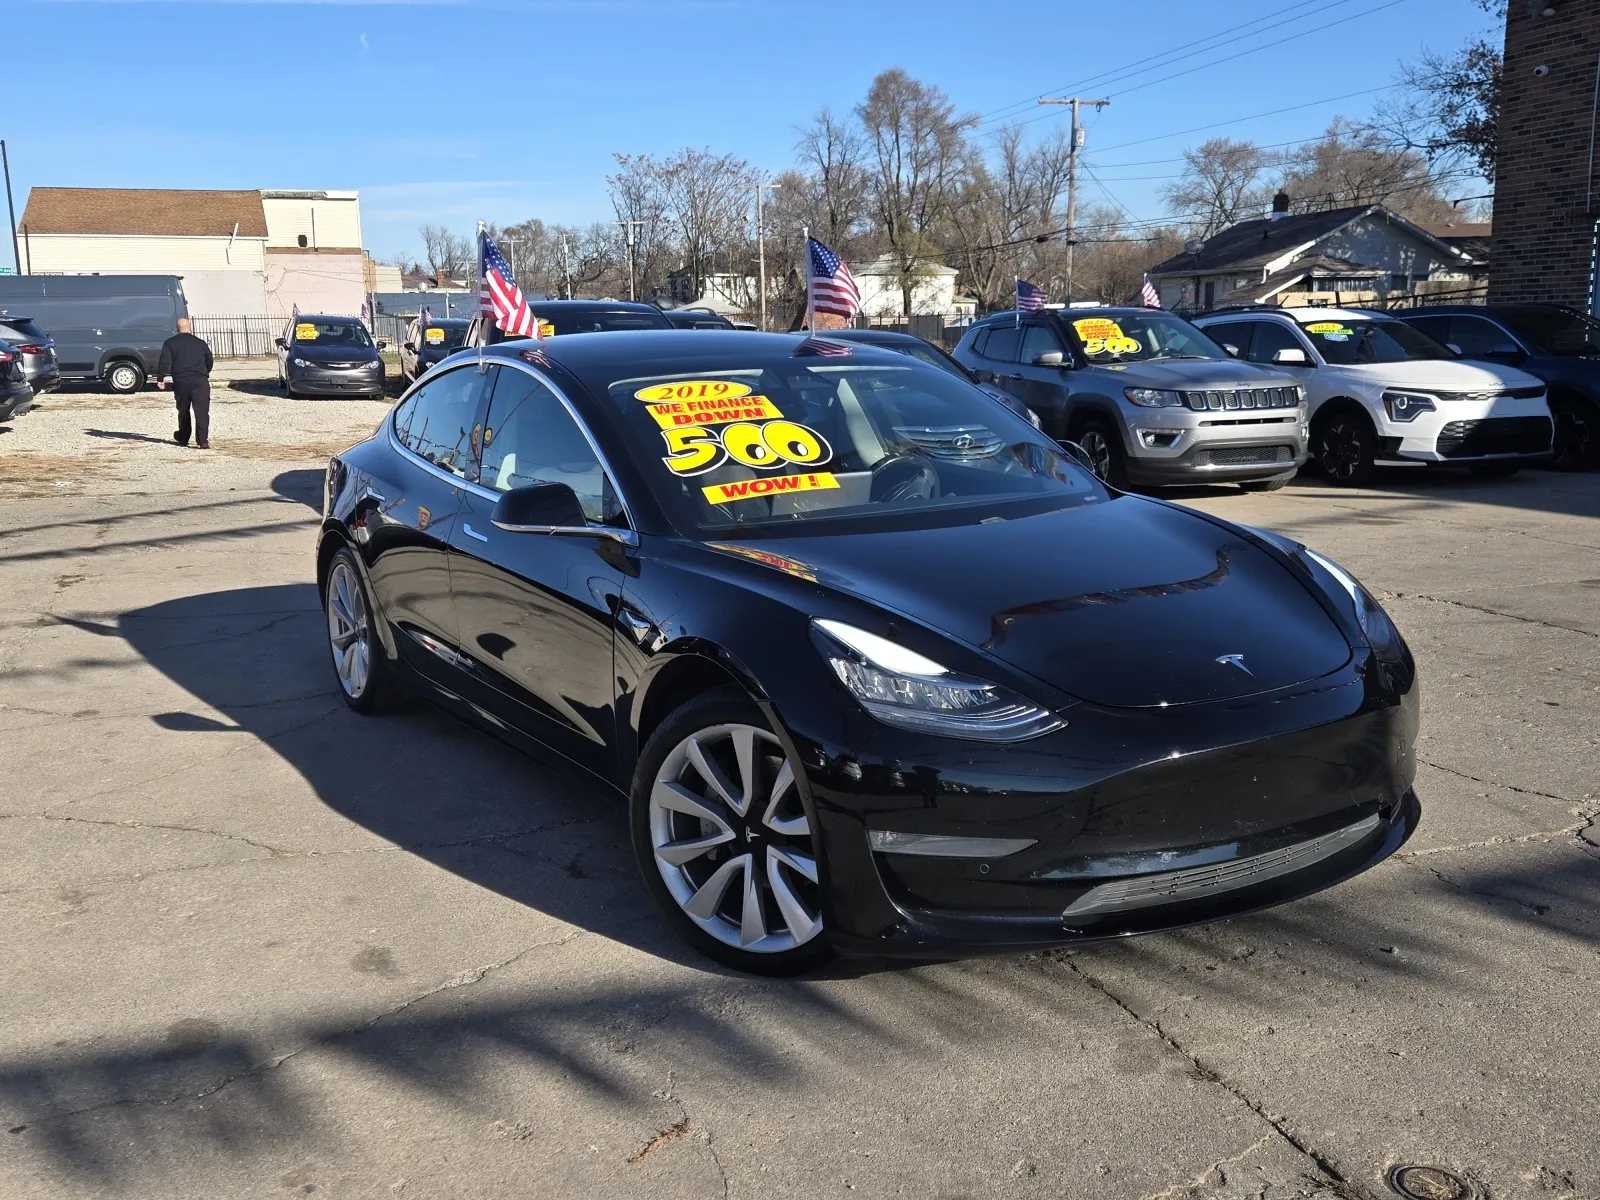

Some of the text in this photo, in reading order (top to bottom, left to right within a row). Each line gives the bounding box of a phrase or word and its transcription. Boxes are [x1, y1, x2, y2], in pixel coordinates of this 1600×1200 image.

[1084, 337, 1142, 355] 500
[658, 383, 730, 400] 2019
[653, 397, 765, 416] WE FINANCE
[672, 408, 766, 426] DOWN
[661, 421, 833, 477] 500
[719, 476, 802, 498] WOW
